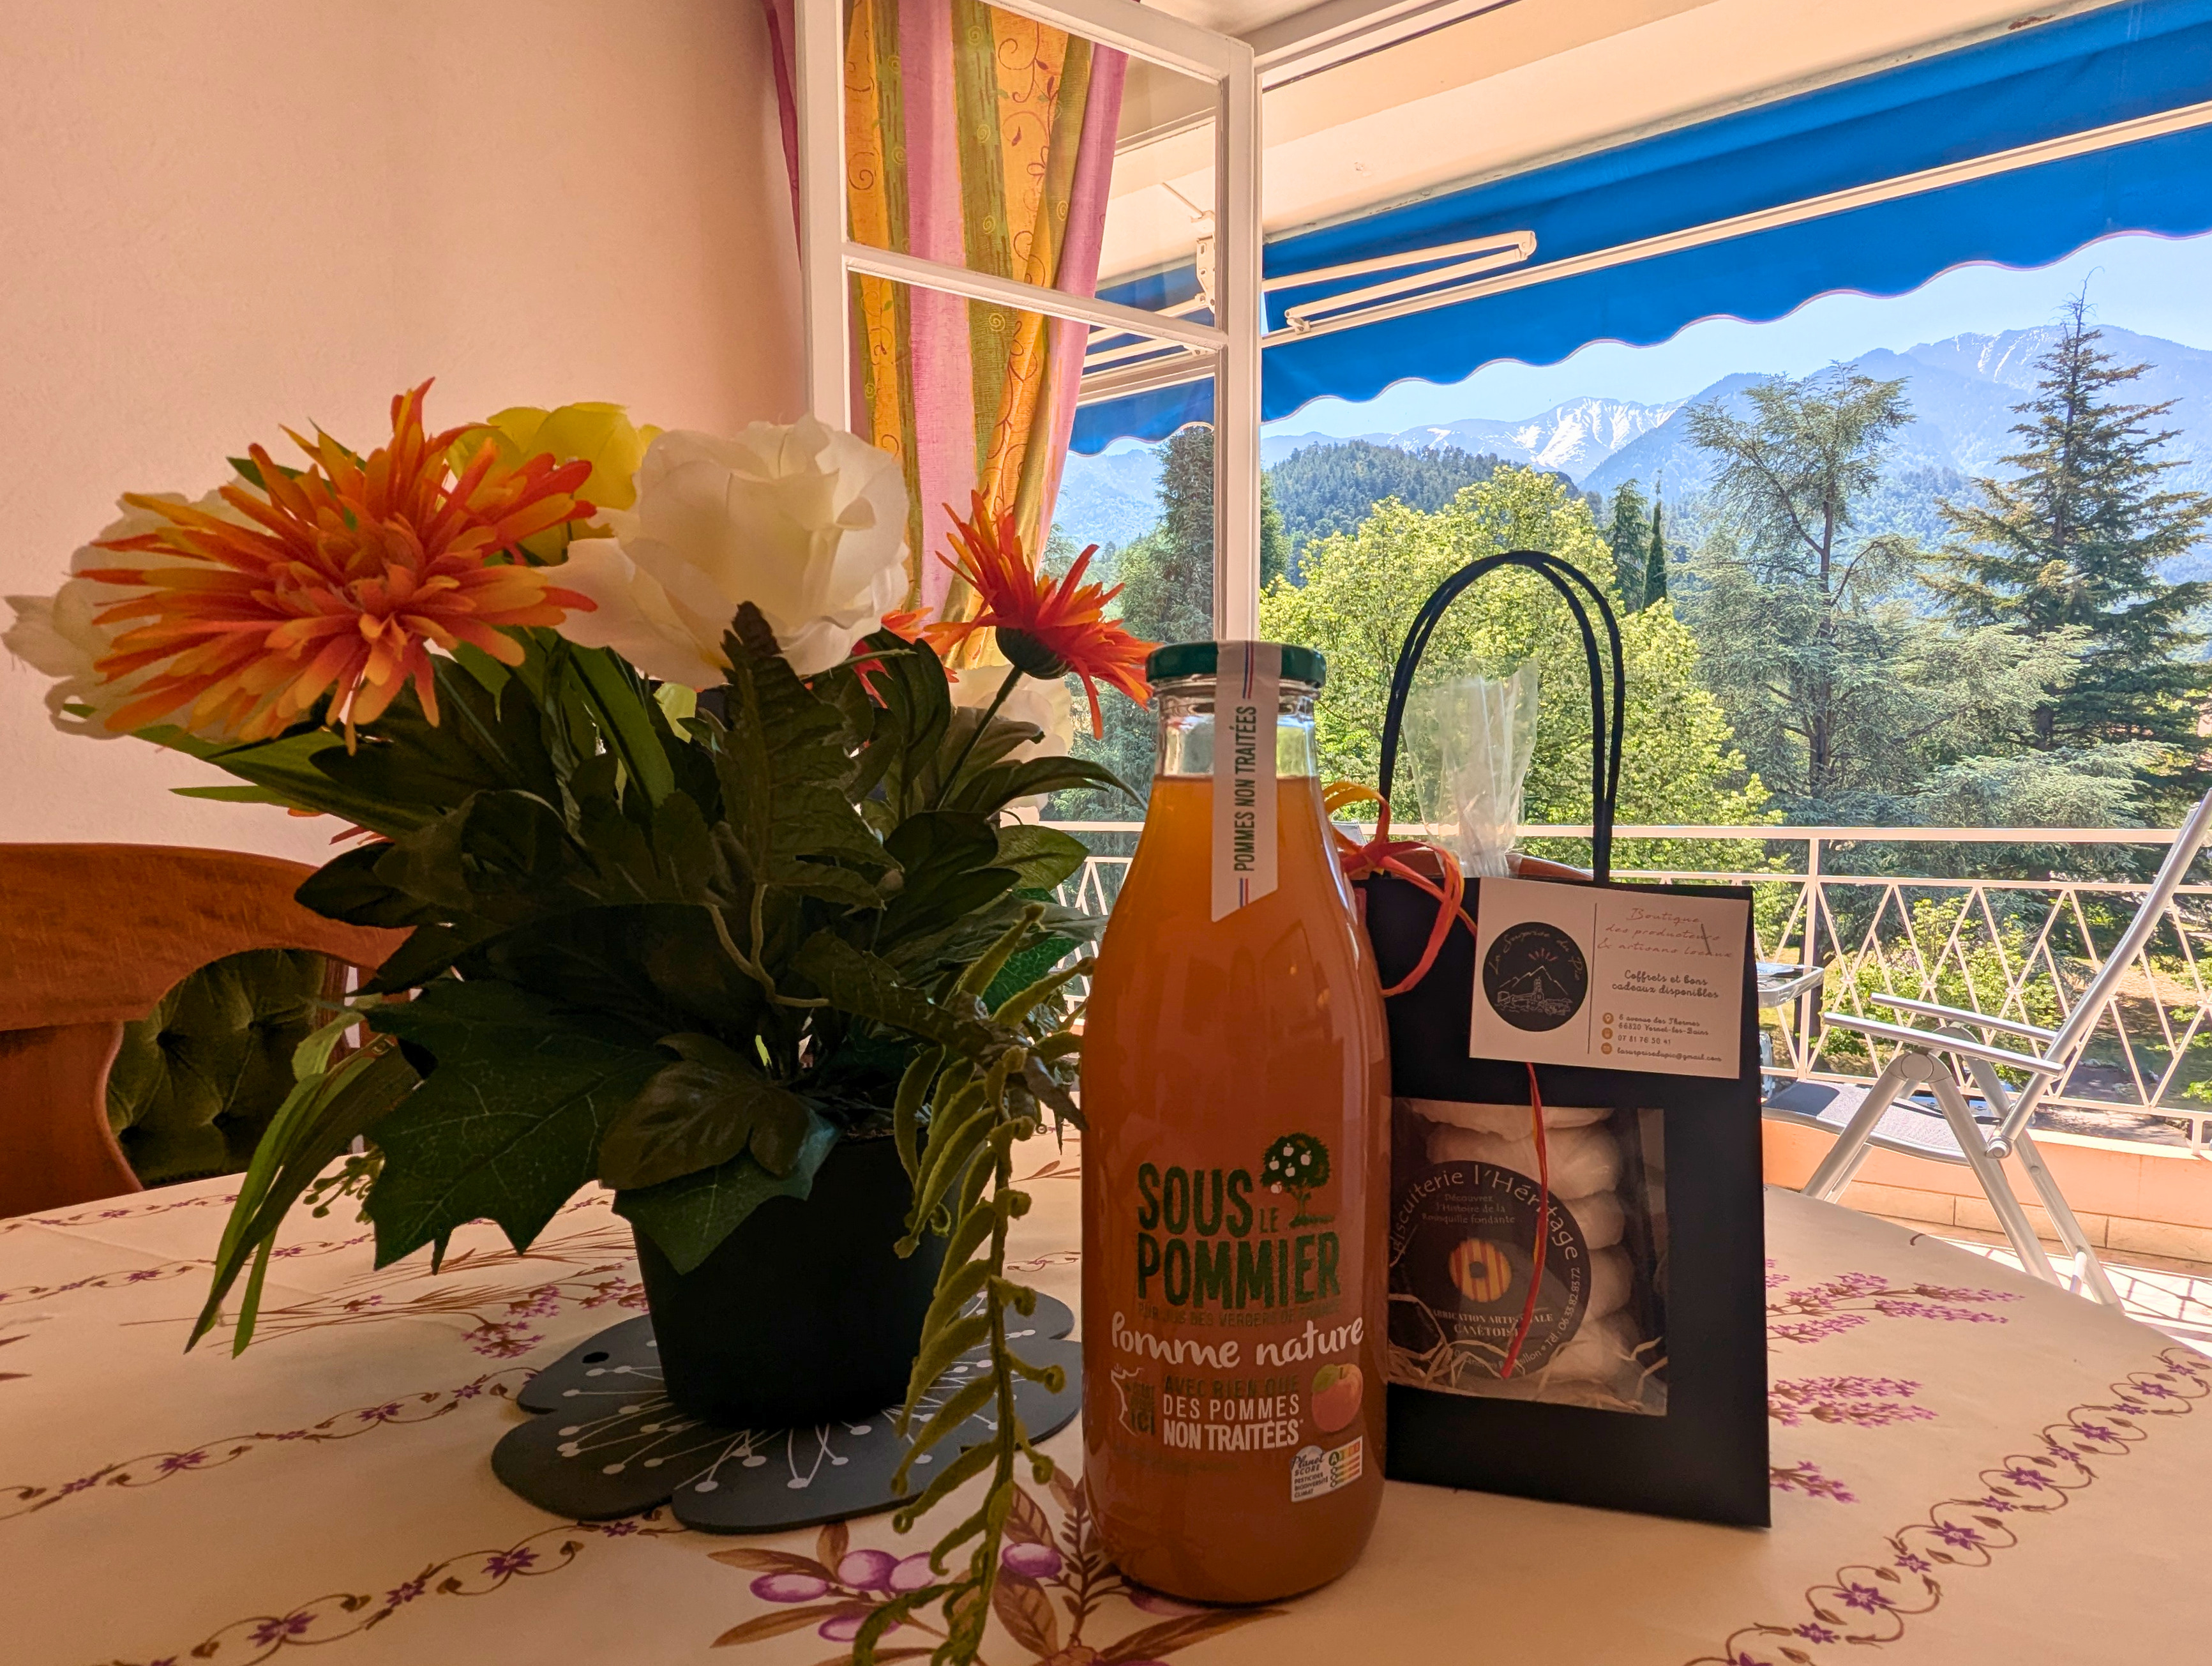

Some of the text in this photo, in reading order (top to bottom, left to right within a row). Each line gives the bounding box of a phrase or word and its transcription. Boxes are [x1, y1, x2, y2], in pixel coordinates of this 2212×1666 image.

[1229, 706, 1256, 872] POMMES NON TRAITÉES
[1626, 908, 1701, 927] Boutique
[1606, 923, 1721, 941] des producteurs
[1618, 942, 1678, 953] artisans
[1625, 969, 1708, 985] Coffrets et bons
[1612, 981, 1719, 998] cadeaux disponibles
[1138, 1163, 1279, 1238] SOUS LE
[1138, 1232, 1341, 1310] POMMIER
[1190, 1312, 1213, 1326] DES
[1219, 1311, 1277, 1327] VERGERS
[1432, 1310, 1553, 1324] ABRICATION ARTISALE
[1112, 1311, 1240, 1368] Pomme
[1256, 1317, 1364, 1367] nature
[1454, 1323, 1519, 1337] CANÉTOIS
[1165, 1374, 1205, 1398] AVEC
[1212, 1379, 1257, 1399] RIEN
[1265, 1375, 1298, 1393] QUE
[1163, 1393, 1200, 1420] DES
[1210, 1393, 1300, 1421] POMMES
[1163, 1418, 1201, 1450] NON
[1290, 1451, 1325, 1470] Planet
[1295, 1464, 1321, 1476] SCORE
